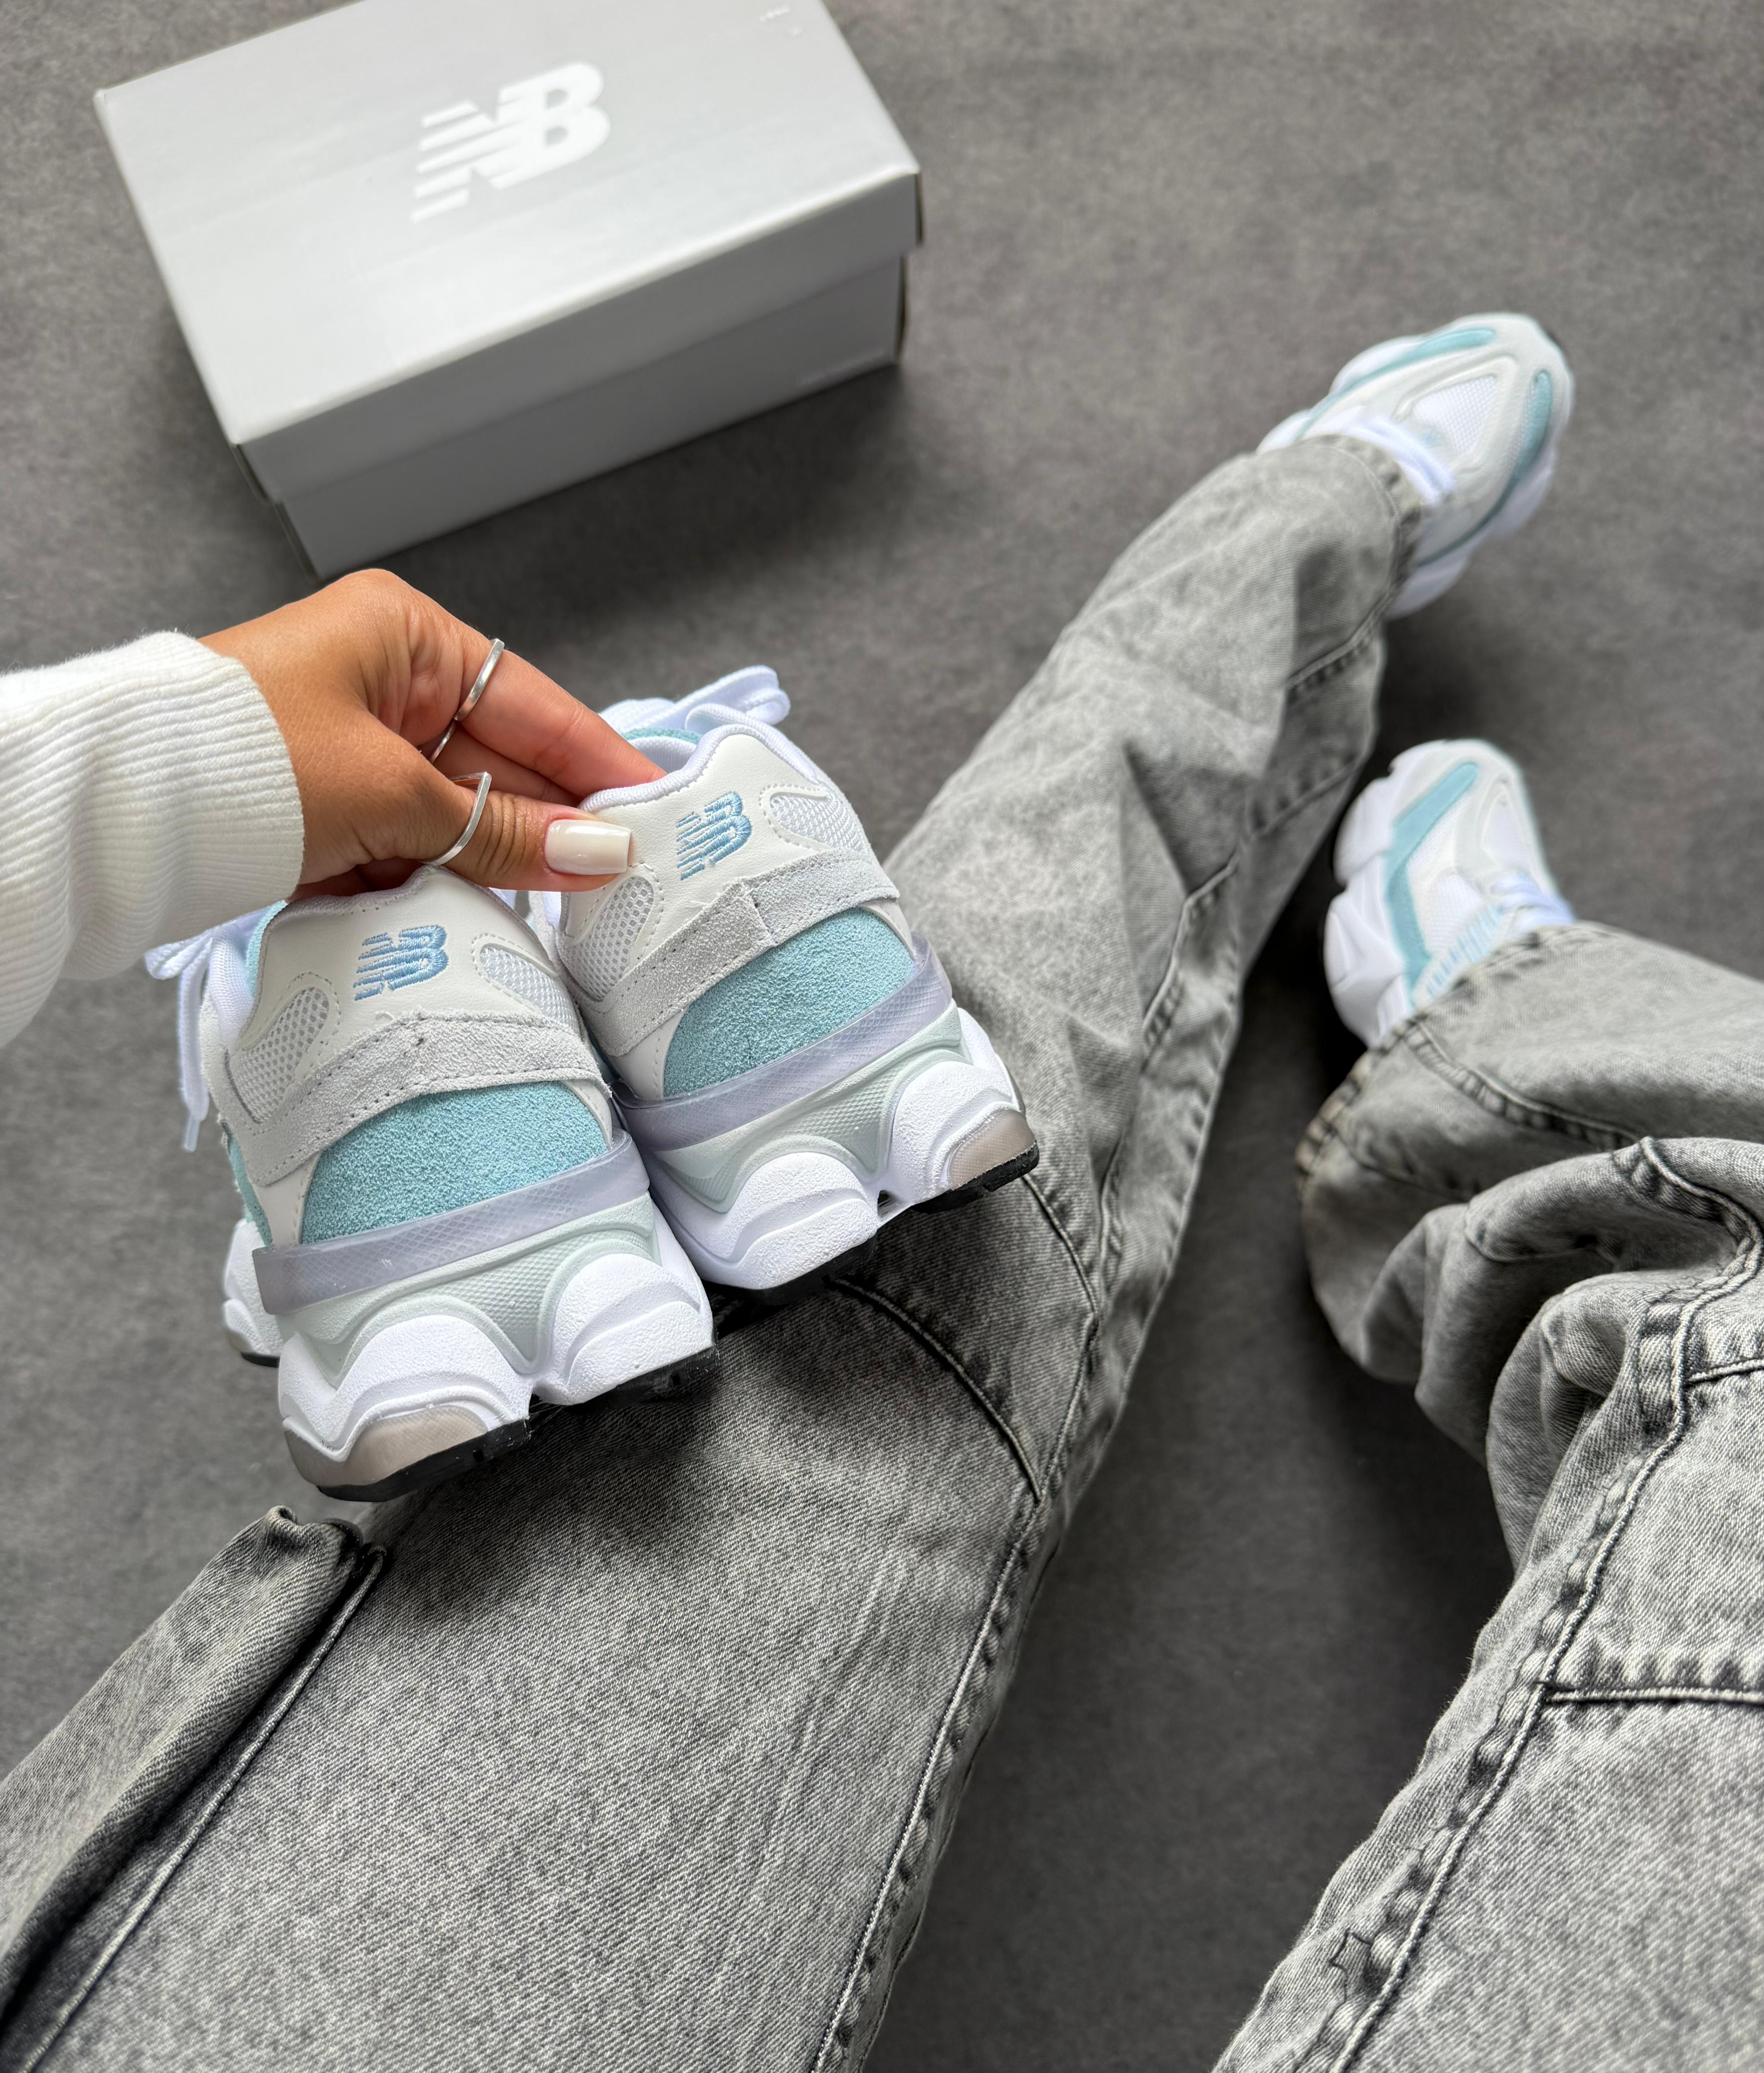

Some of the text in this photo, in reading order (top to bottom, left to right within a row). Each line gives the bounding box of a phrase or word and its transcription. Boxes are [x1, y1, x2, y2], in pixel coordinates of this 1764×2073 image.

[410, 61, 611, 223] NB
[676, 790, 752, 881] NB
[353, 924, 449, 1001] NB
